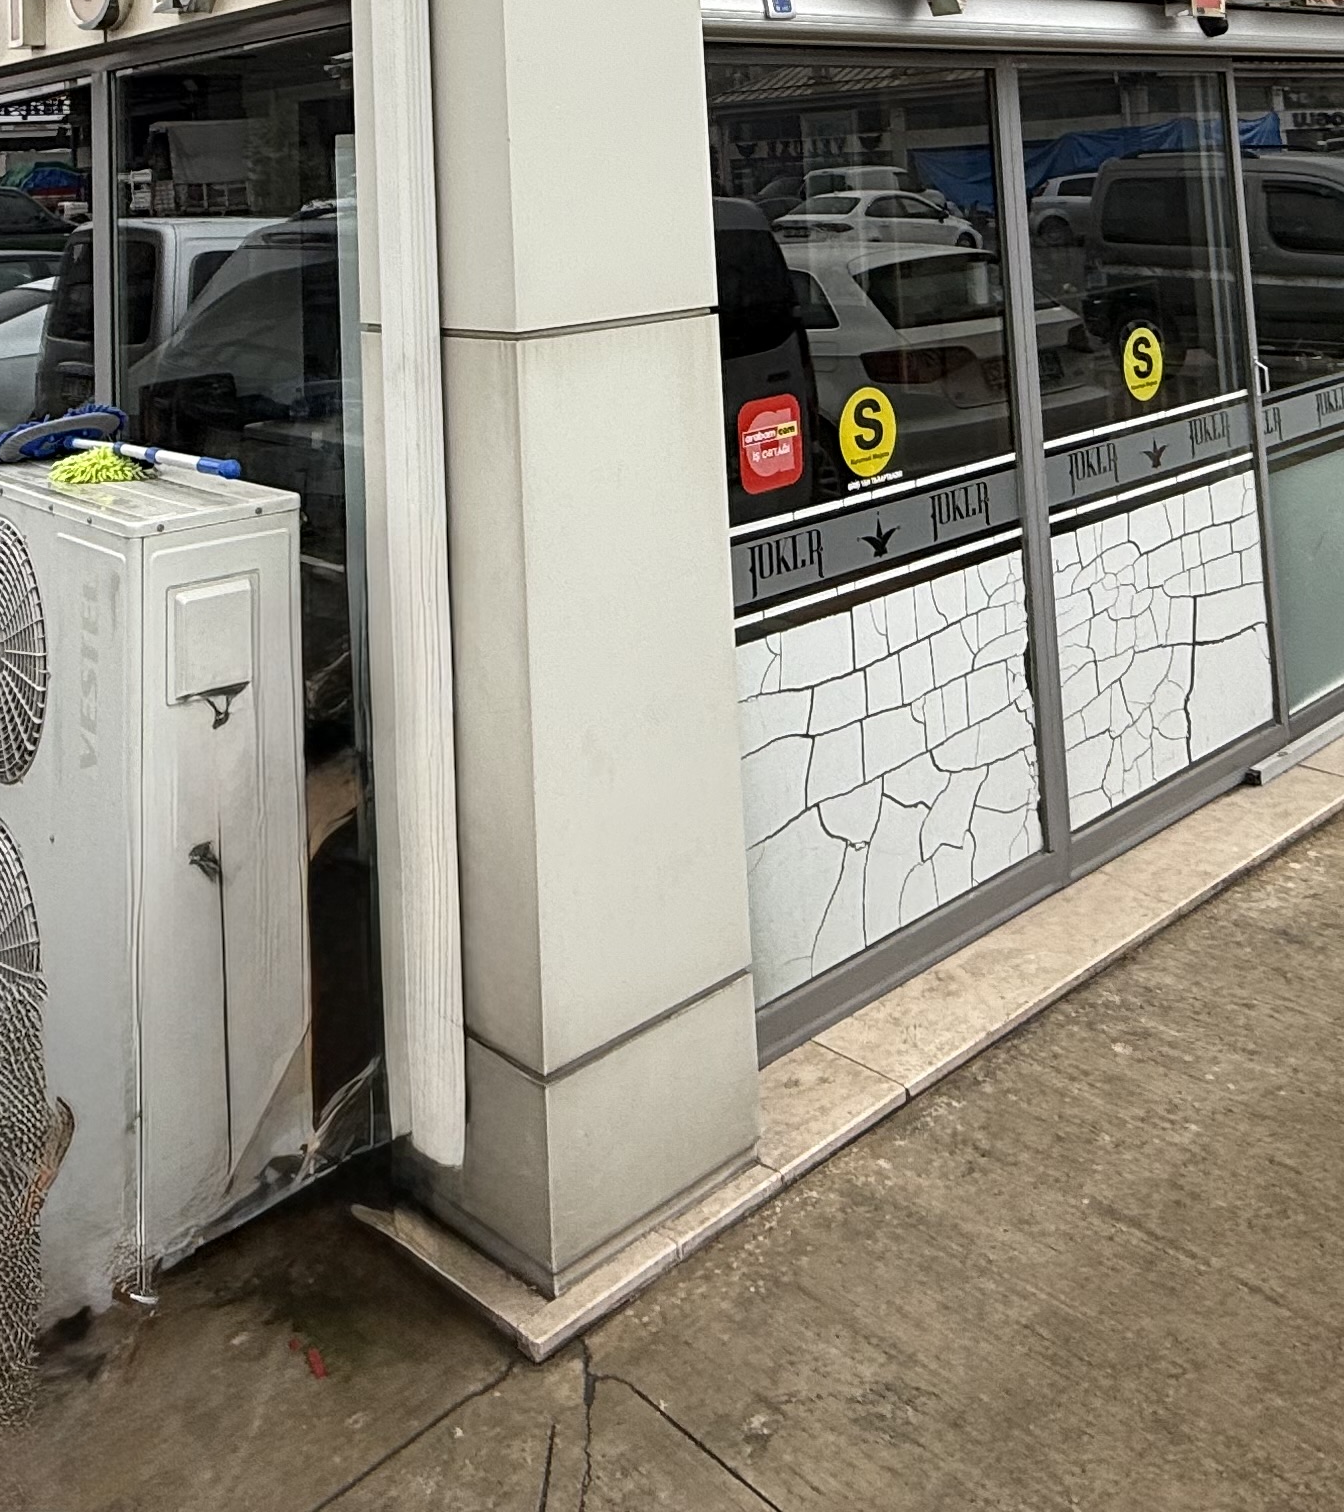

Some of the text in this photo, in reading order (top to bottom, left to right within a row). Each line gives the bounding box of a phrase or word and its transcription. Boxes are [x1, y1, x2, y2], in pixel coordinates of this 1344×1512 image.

[1133, 336, 1153, 379] S
[854, 398, 883, 450] S
[1067, 442, 1120, 496] JOKER
[1188, 410, 1231, 459] JOKER
[747, 481, 991, 600] JOKER JOKER
